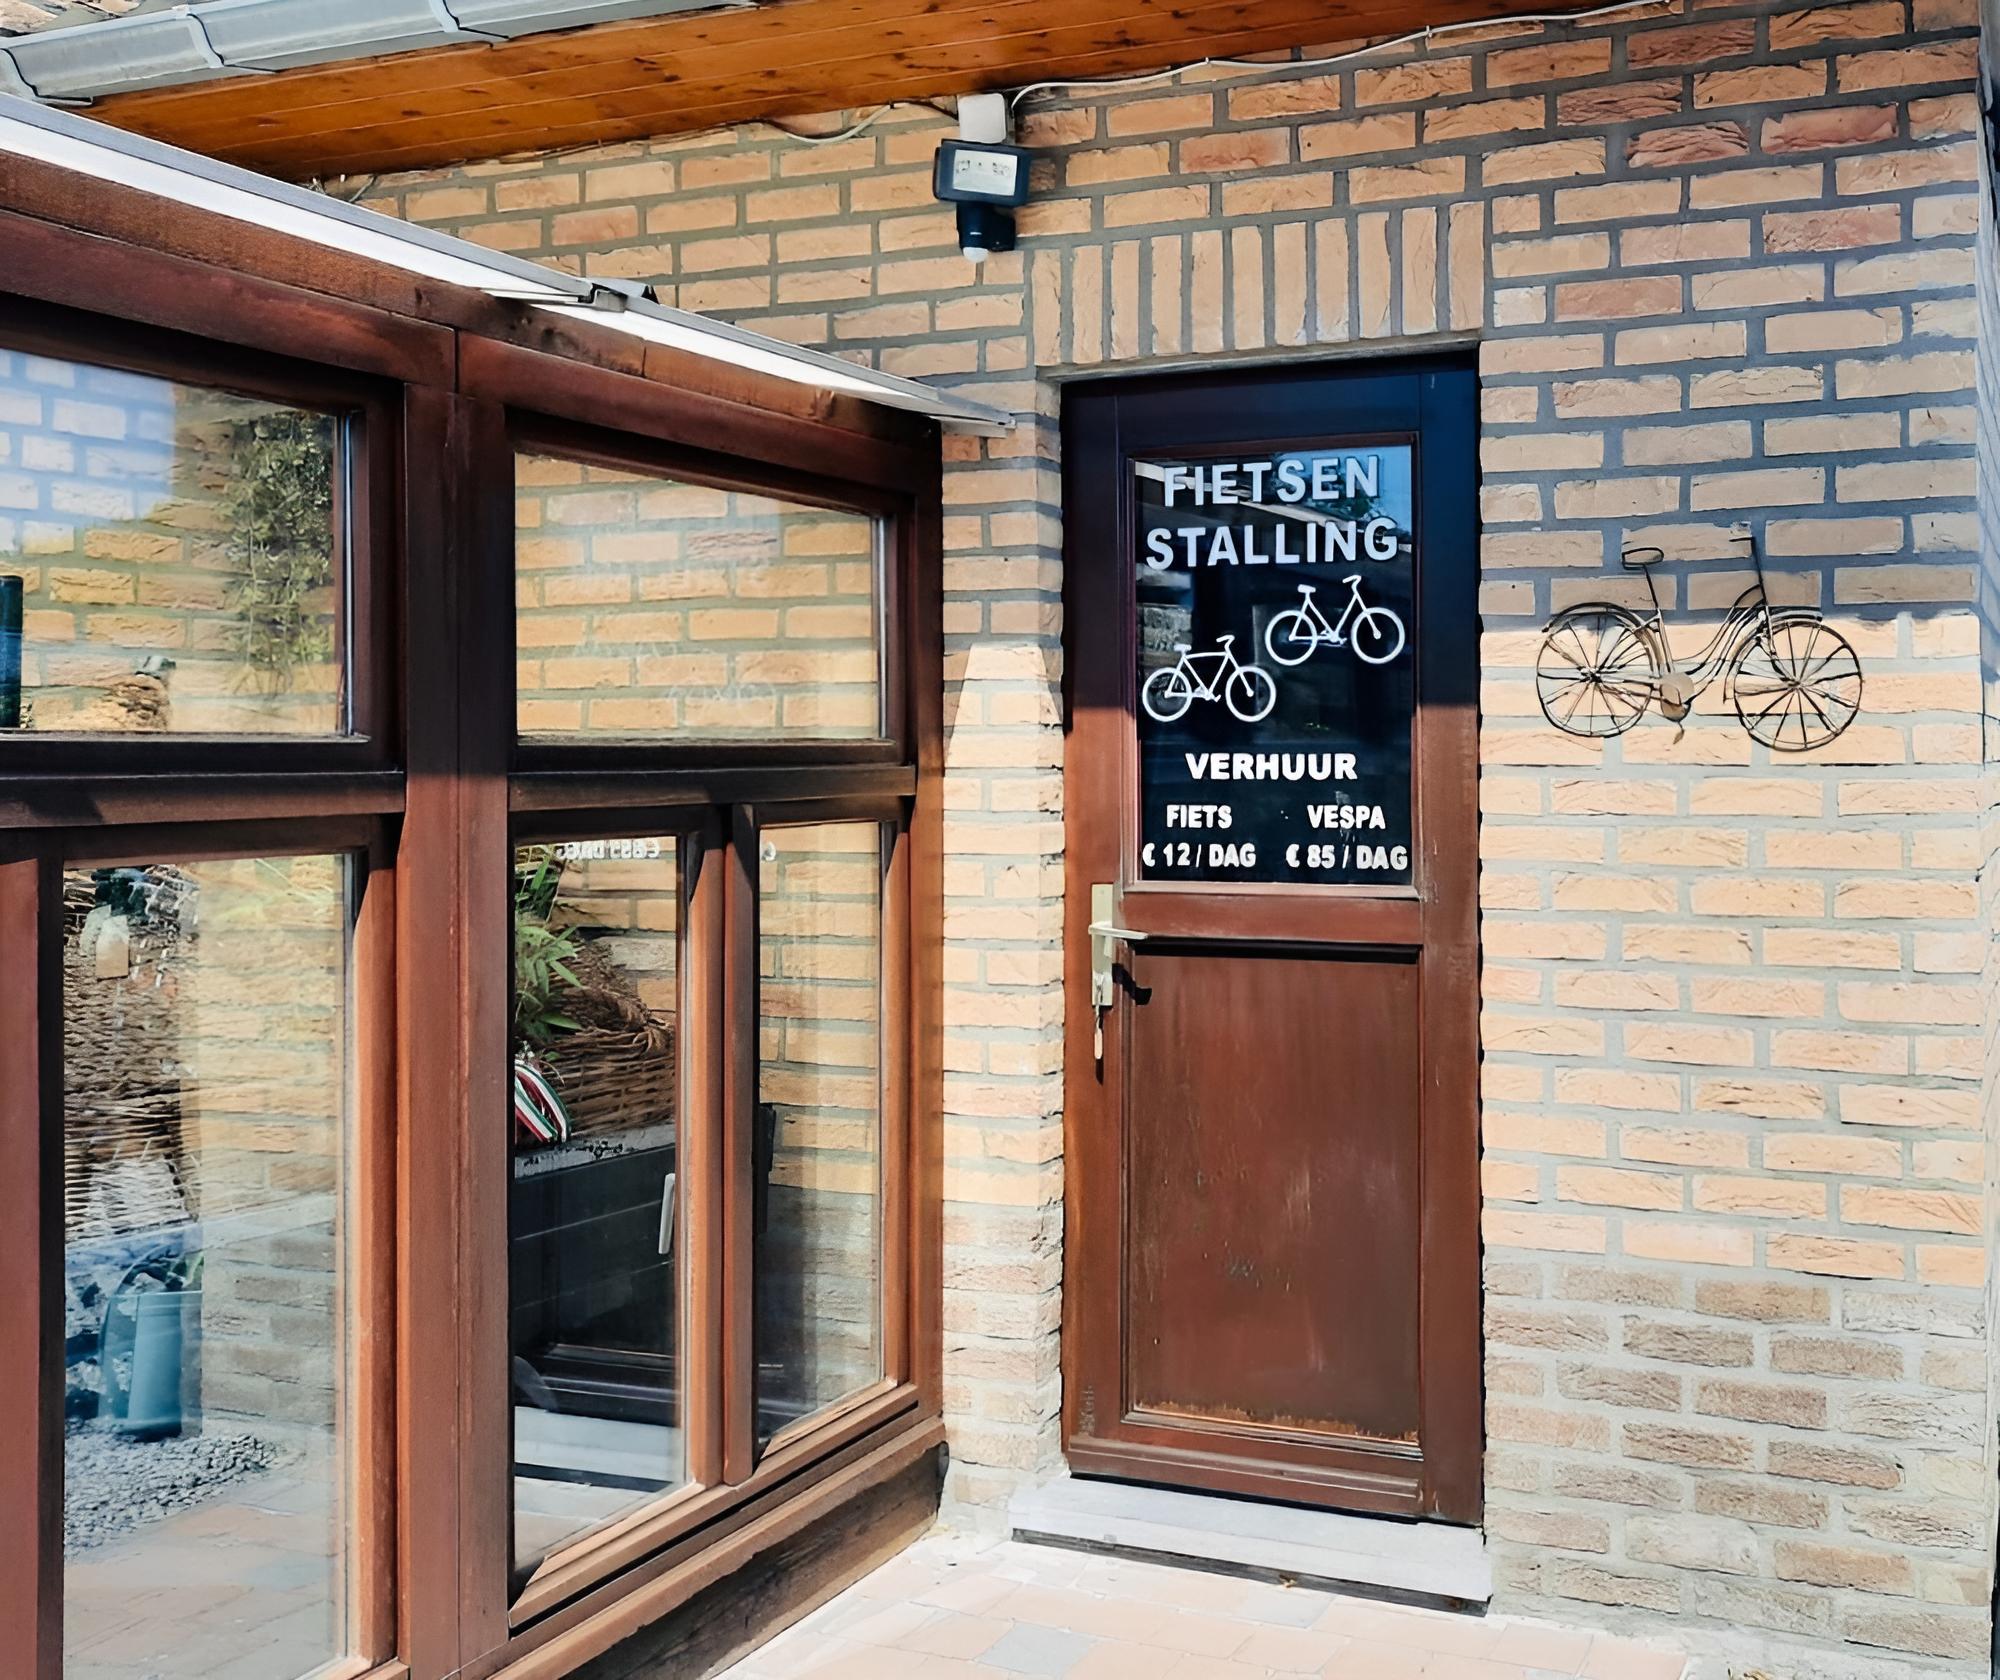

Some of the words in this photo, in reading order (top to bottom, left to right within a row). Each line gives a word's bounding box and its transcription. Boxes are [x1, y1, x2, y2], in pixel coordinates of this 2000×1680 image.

[1163, 455, 1379, 507] FIETSEN
[1145, 516, 1398, 571] STALLING
[1185, 752, 1358, 781] VERHUUR
[1166, 804, 1233, 829] FIETS
[1307, 804, 1386, 830] VESPA
